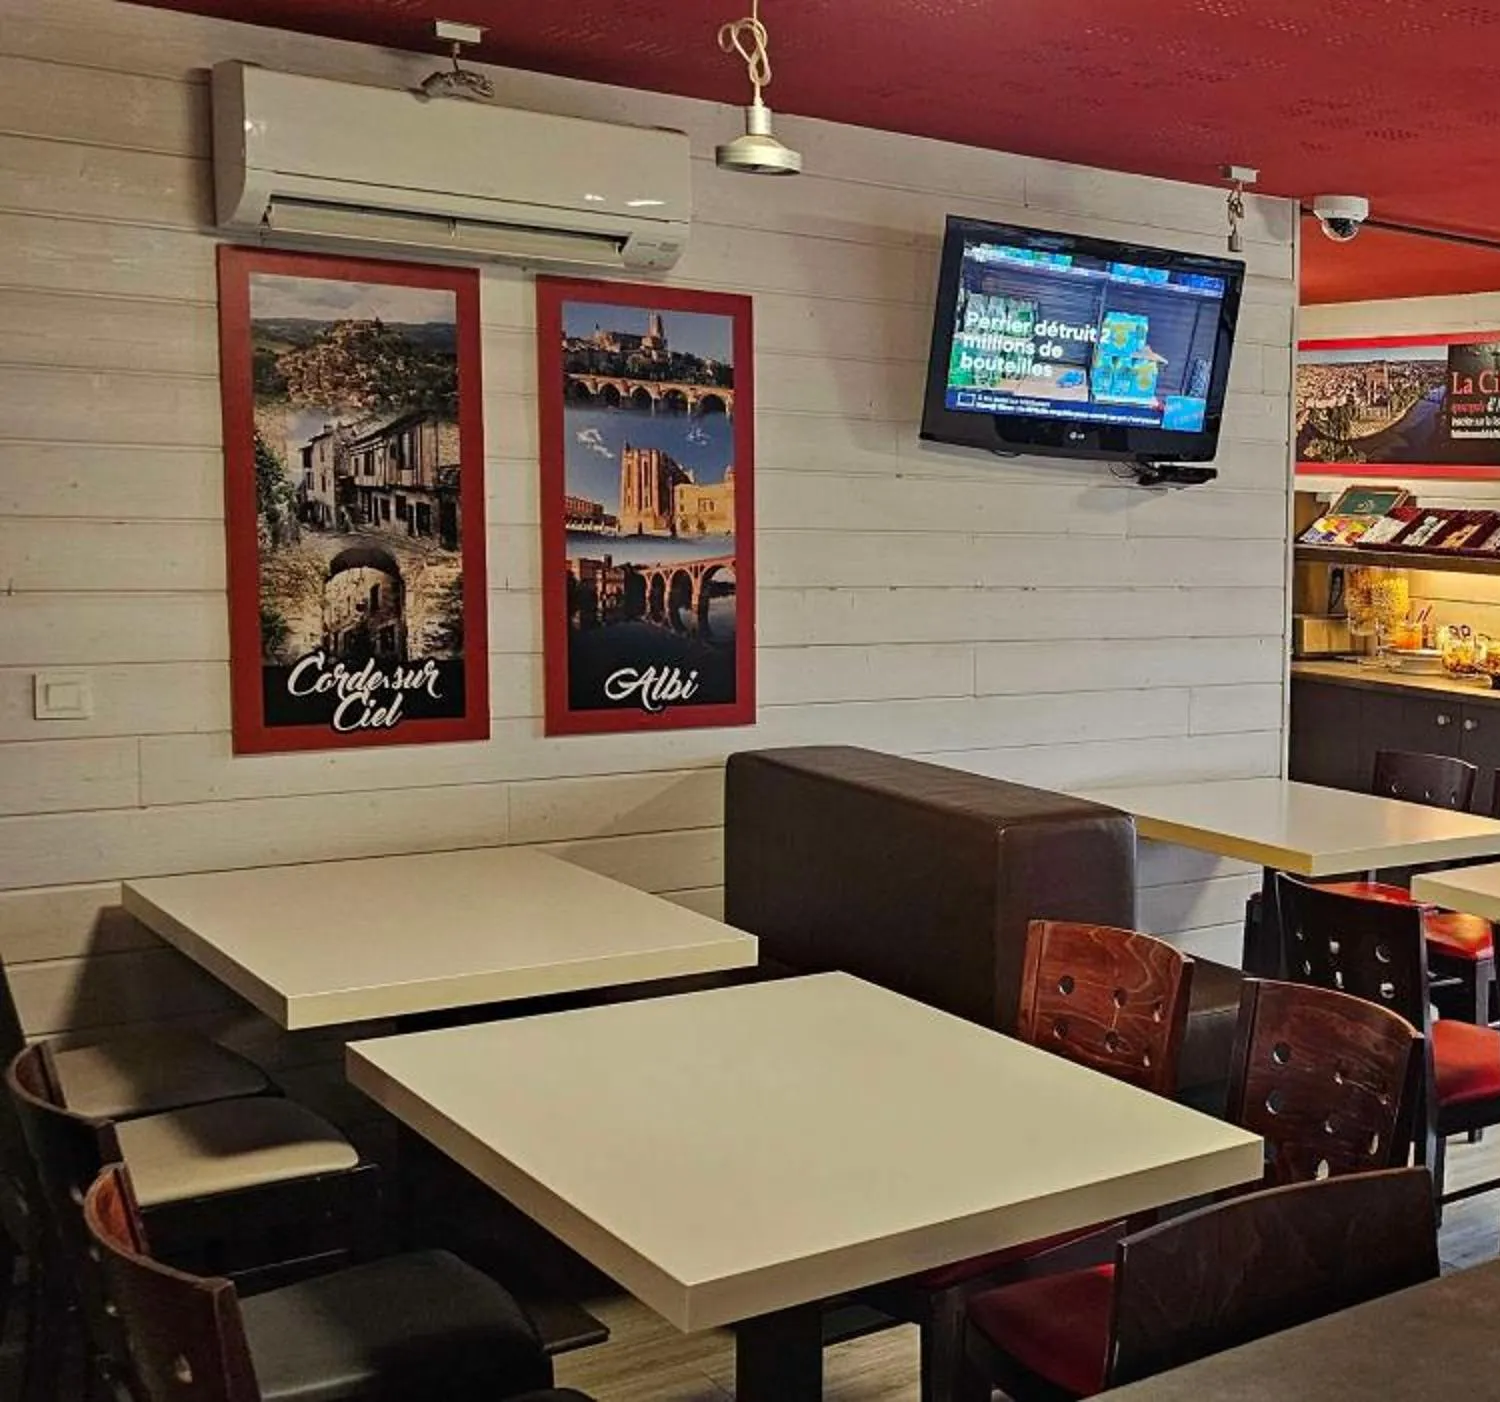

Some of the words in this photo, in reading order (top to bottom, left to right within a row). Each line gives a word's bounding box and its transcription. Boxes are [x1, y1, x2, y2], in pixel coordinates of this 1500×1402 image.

[965, 310, 1032, 334] Perrier
[1034, 319, 1097, 343] détruit
[1099, 329, 1112, 344] 2
[962, 332, 1036, 356] millions
[1039, 341, 1064, 359] de
[960, 351, 1053, 377] bouteilles
[1451, 371, 1473, 395] La
[391, 659, 443, 699] sur
[604, 665, 699, 711] Albi
[333, 692, 404, 731] Ciel
